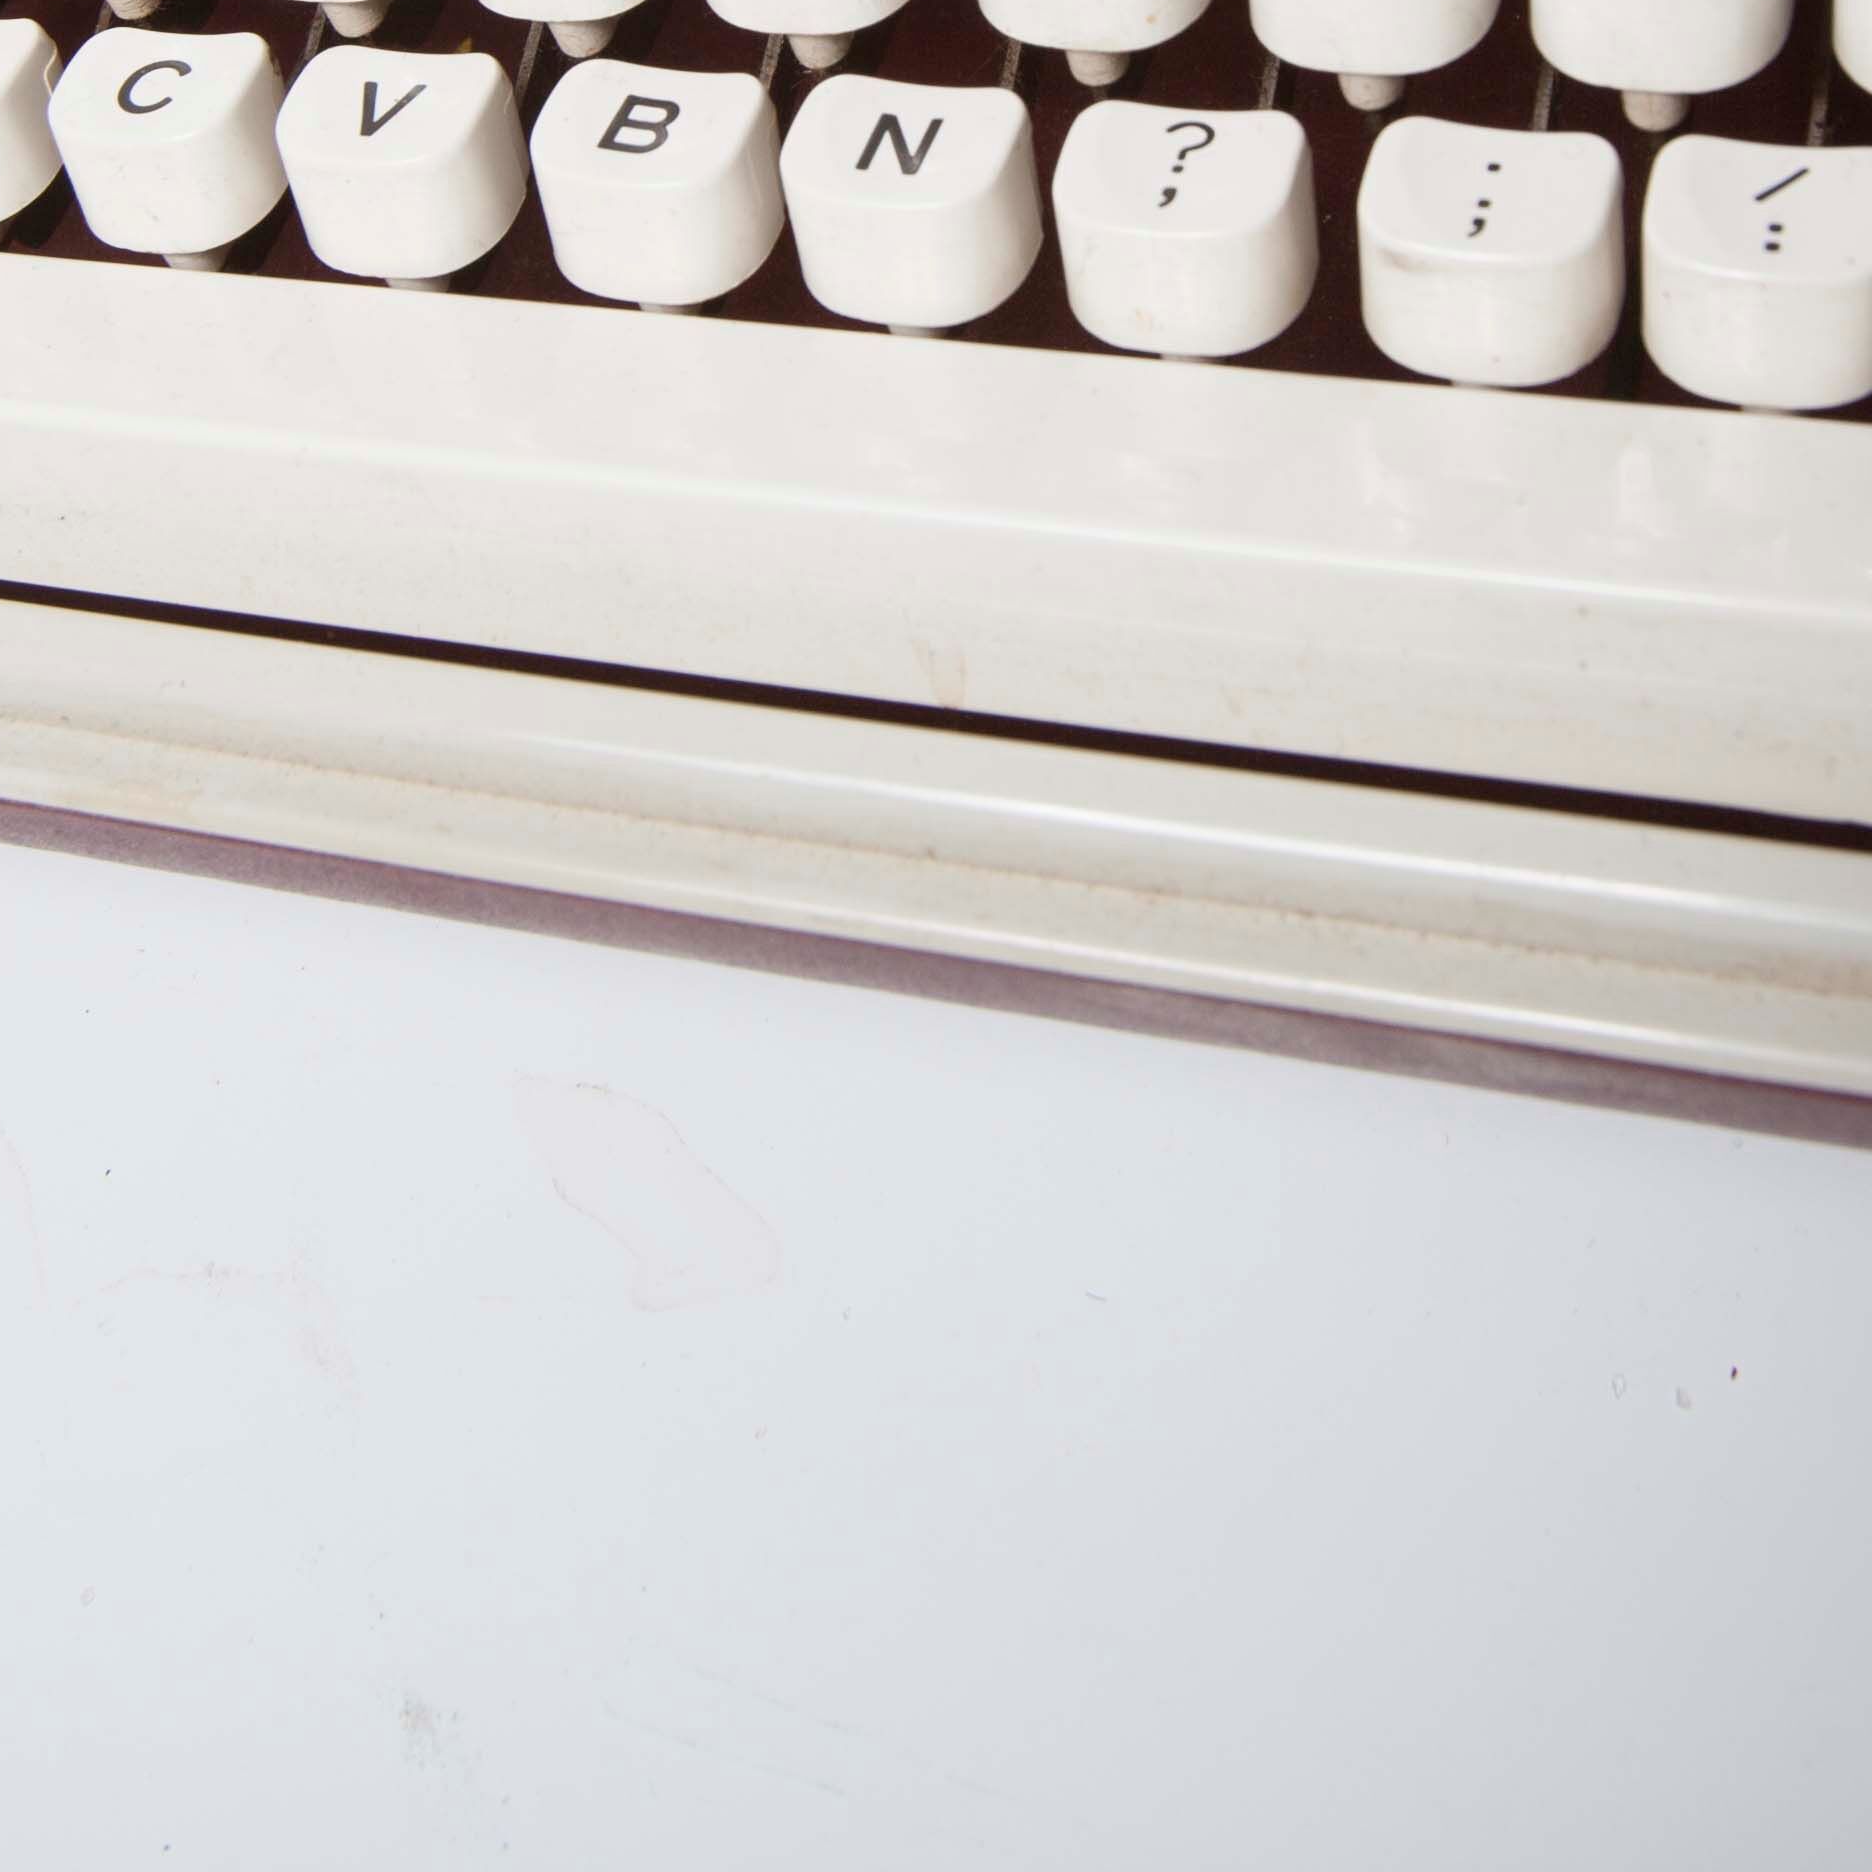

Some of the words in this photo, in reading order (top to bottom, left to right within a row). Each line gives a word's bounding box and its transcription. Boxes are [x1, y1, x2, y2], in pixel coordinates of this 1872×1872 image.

[117, 60, 192, 115] C
[359, 81, 427, 137] V
[597, 94, 681, 154] B
[855, 113, 944, 175] N
[1166, 121, 1216, 173] ?
